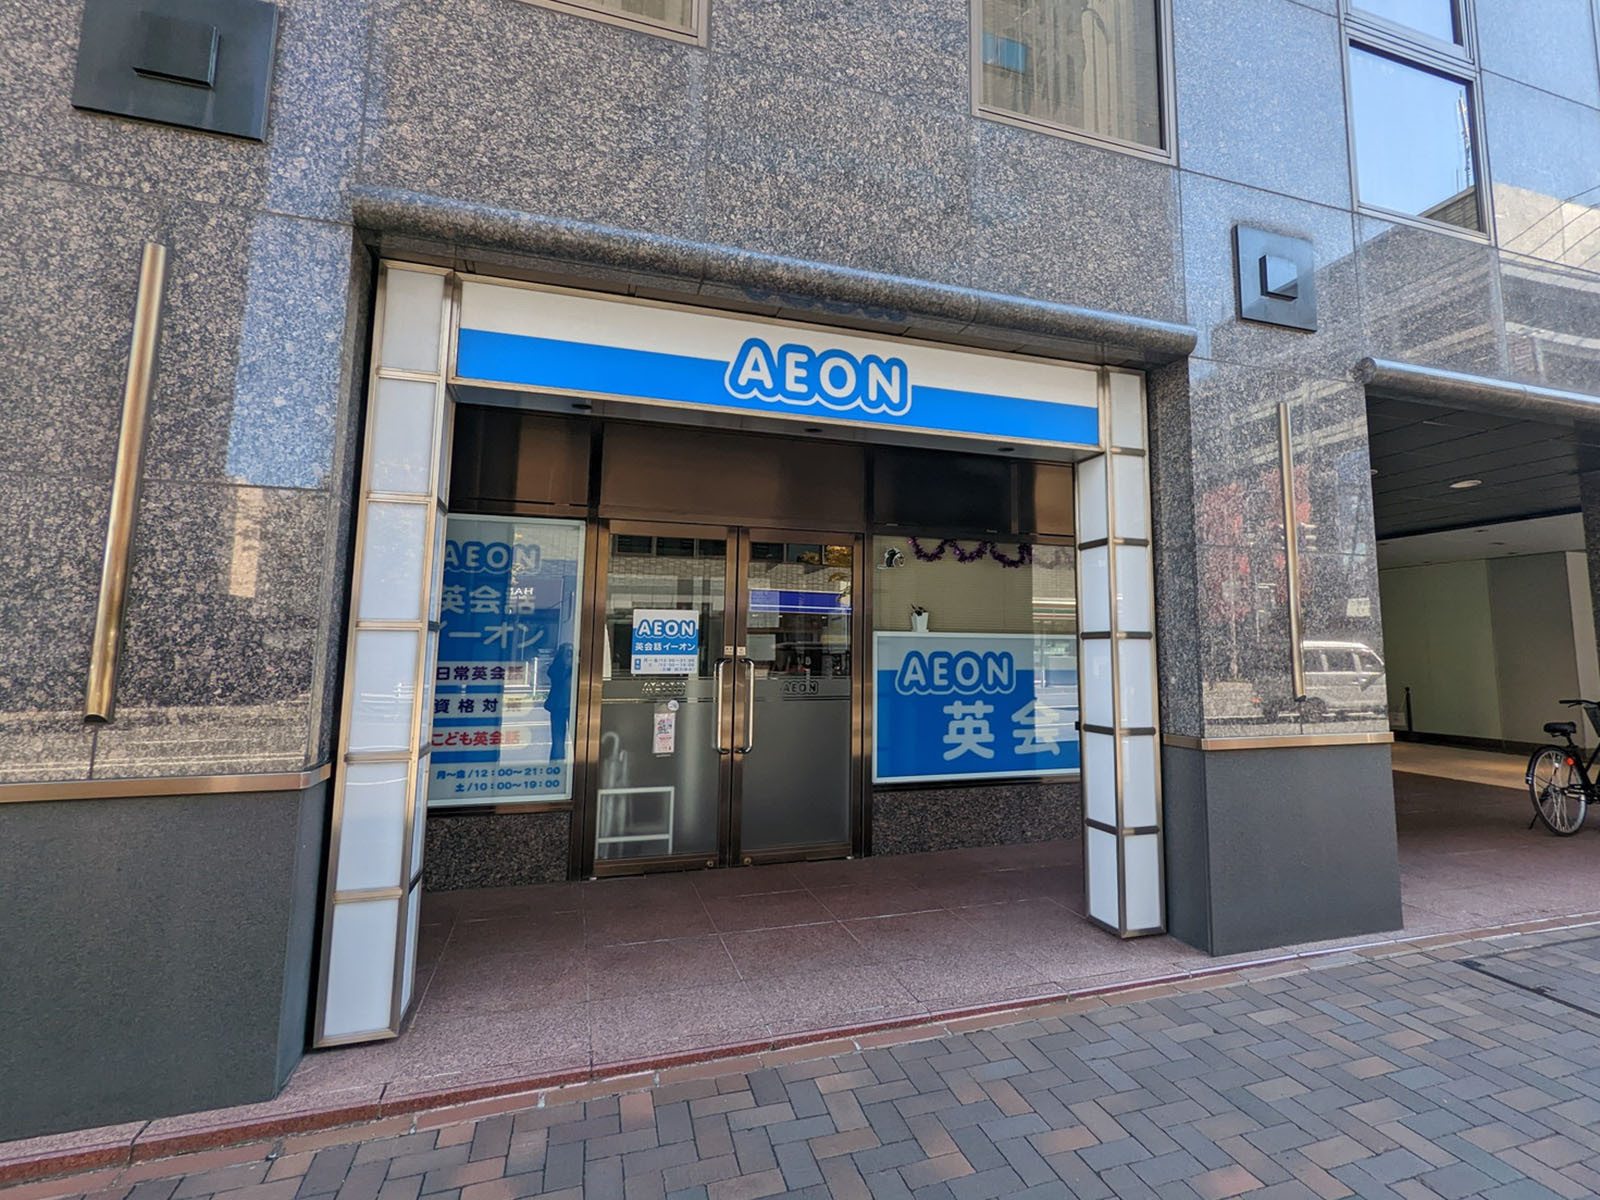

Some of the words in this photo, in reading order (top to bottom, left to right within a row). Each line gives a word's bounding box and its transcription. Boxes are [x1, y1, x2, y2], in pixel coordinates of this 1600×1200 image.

[730, 338, 907, 413] AEON
[445, 541, 540, 572] AEON
[439, 621, 545, 649] ーオン
[637, 619, 695, 637] AEON
[437, 666, 523, 681] 日常英会話
[899, 651, 1013, 692] AEON
[783, 681, 817, 695] AEON
[431, 731, 521, 746] こども英会話
